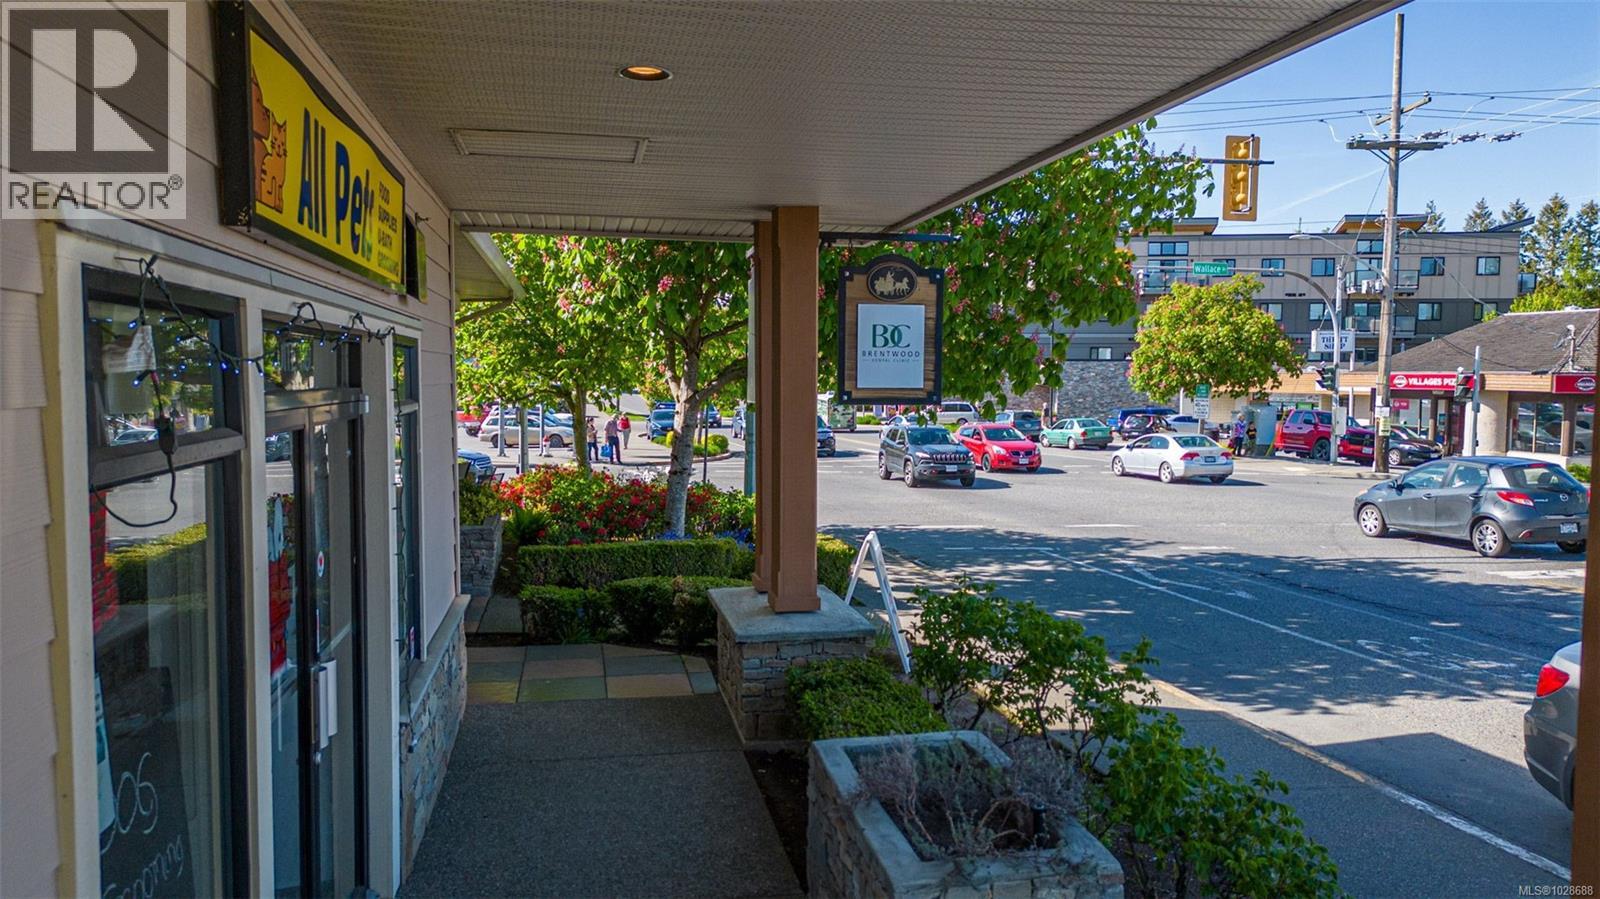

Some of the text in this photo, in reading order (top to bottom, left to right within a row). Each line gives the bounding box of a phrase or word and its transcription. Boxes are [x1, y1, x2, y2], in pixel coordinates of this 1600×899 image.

[297, 107, 375, 263] All Pets
[1194, 263, 1221, 273] Wallace
[861, 350, 921, 358] BRENTWOOD
[1408, 377, 1443, 386] VILLAGES
[1443, 378, 1457, 386] PIZ
